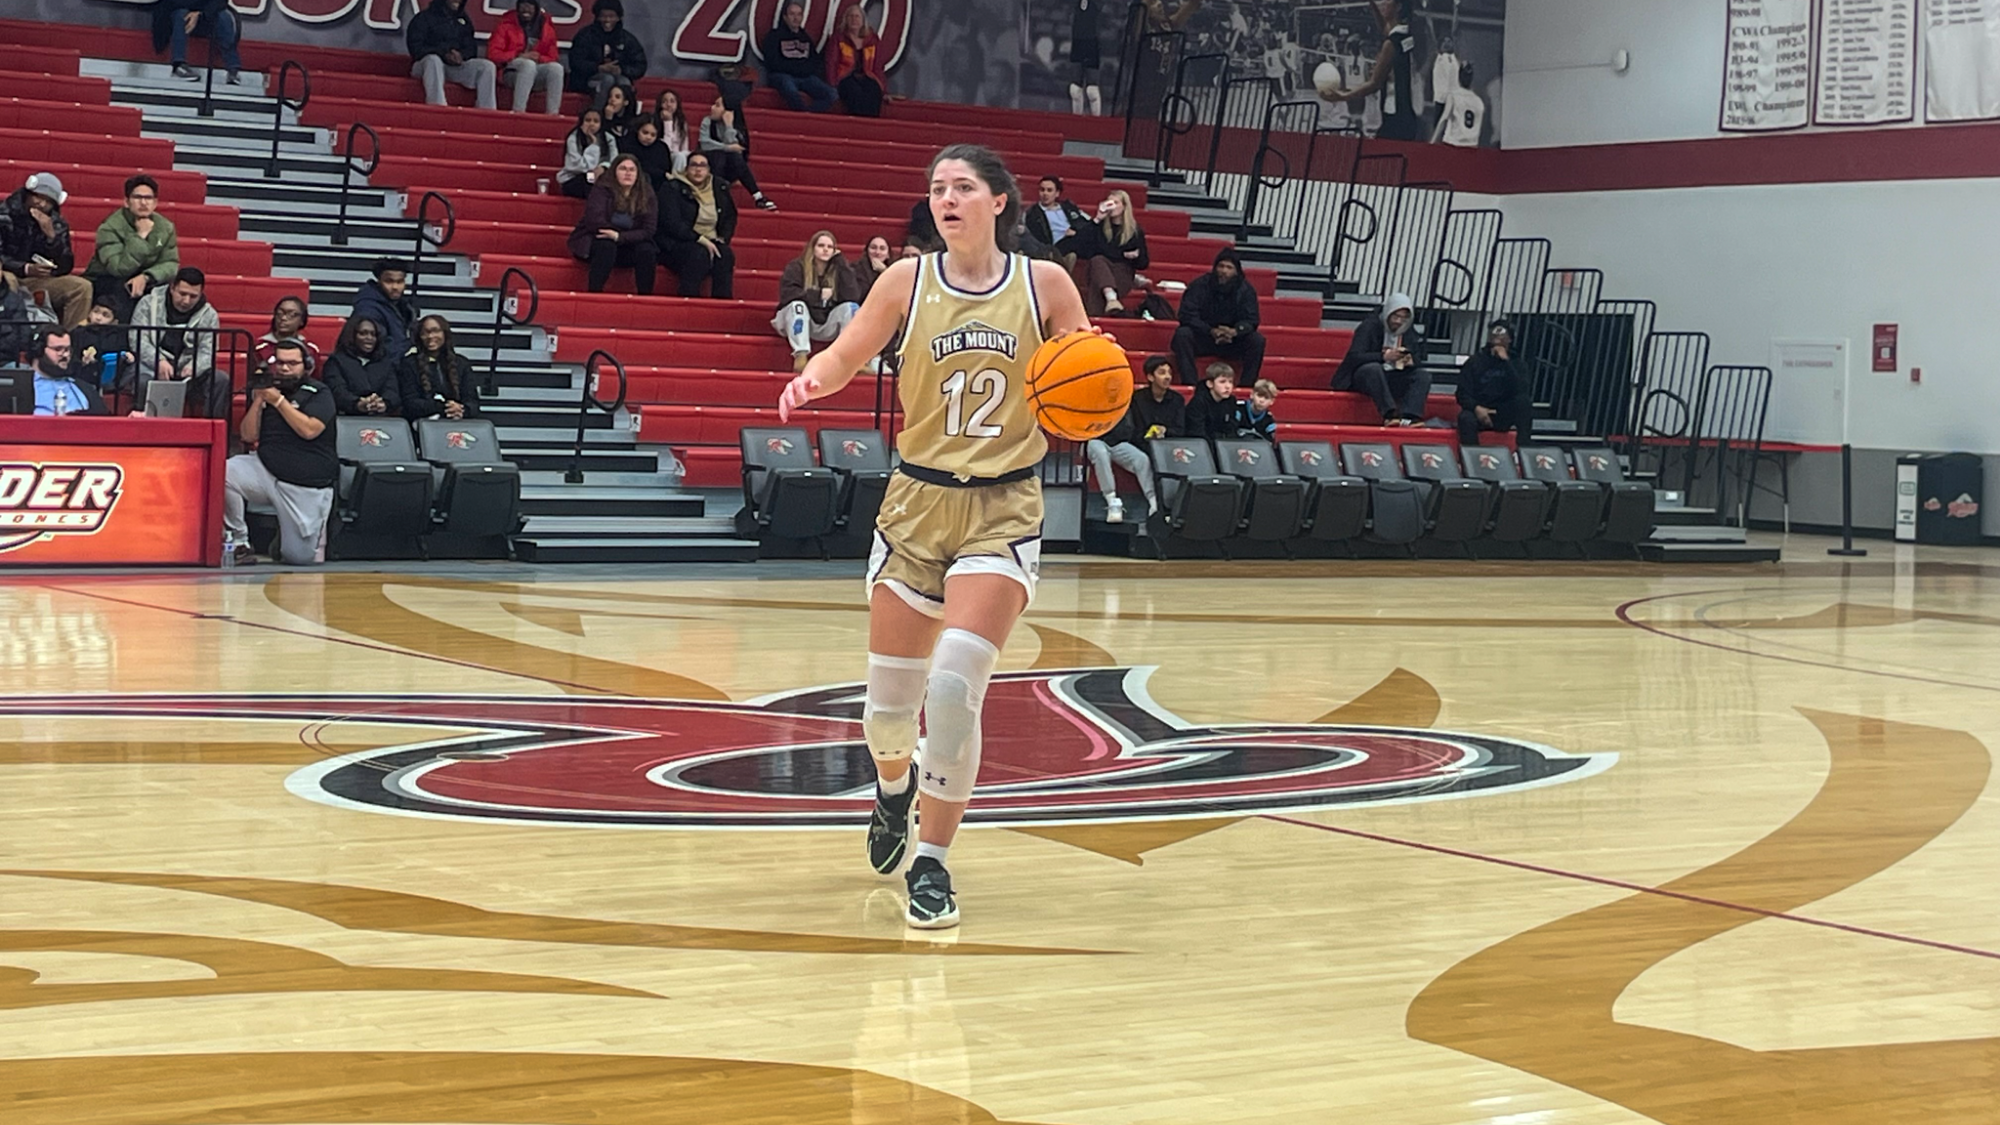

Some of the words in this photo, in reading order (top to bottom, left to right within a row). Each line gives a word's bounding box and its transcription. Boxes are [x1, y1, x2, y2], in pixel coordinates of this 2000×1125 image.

[933, 333, 963, 360] THE
[965, 331, 1016, 360] MOUNT
[941, 367, 1008, 439] 12
